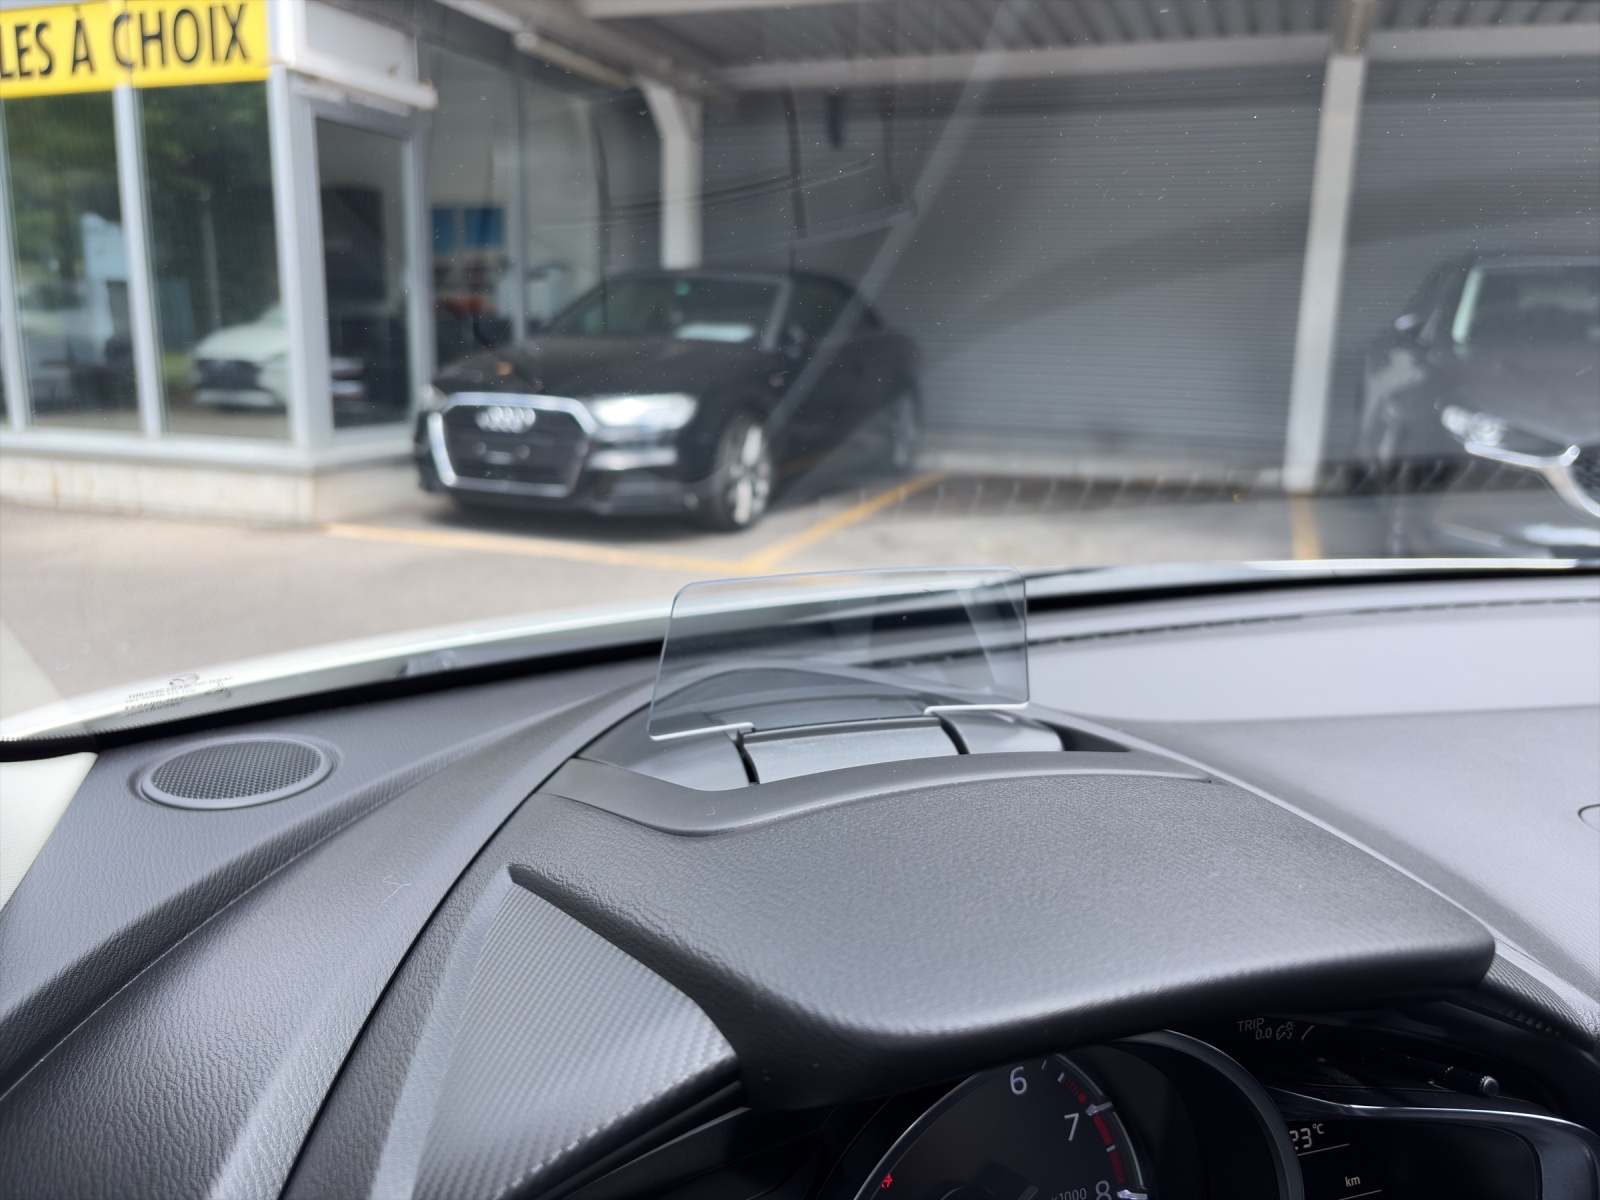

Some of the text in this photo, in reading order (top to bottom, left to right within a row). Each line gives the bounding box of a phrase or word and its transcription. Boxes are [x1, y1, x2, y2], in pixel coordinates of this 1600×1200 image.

[71, 5, 97, 76] À
[112, 3, 249, 73] CHOIX
[1236, 1017, 1265, 1032] TRIP
[1255, 1027, 1273, 1040] 0.0
[1009, 1065, 1028, 1096] 6
[1064, 1112, 1079, 1142] 7
[1344, 1176, 1361, 1188] km
